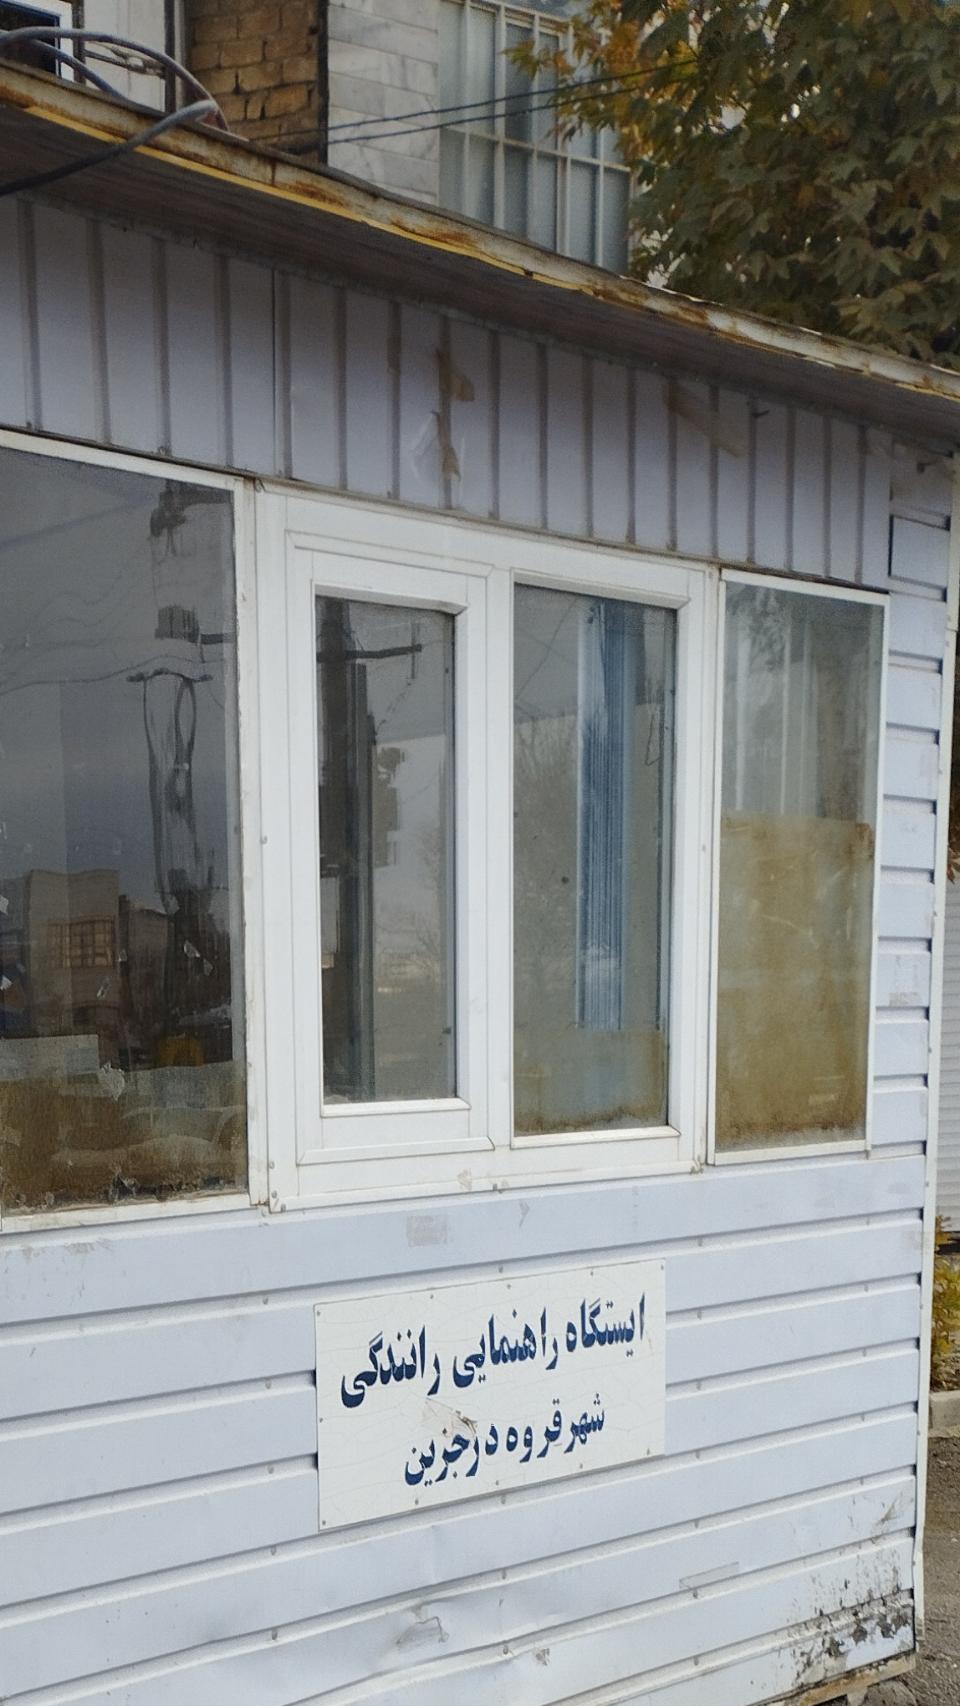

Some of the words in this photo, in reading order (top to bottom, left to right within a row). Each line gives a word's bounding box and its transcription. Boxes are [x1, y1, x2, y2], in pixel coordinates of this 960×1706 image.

[452, 1305, 559, 1388] راهنمایی
[565, 1292, 646, 1357] ایستگاه
[340, 1325, 441, 1408] رانندگی
[404, 1423, 499, 1487] درجزین
[506, 1398, 563, 1463] قروه
[563, 1392, 605, 1455] شهر
